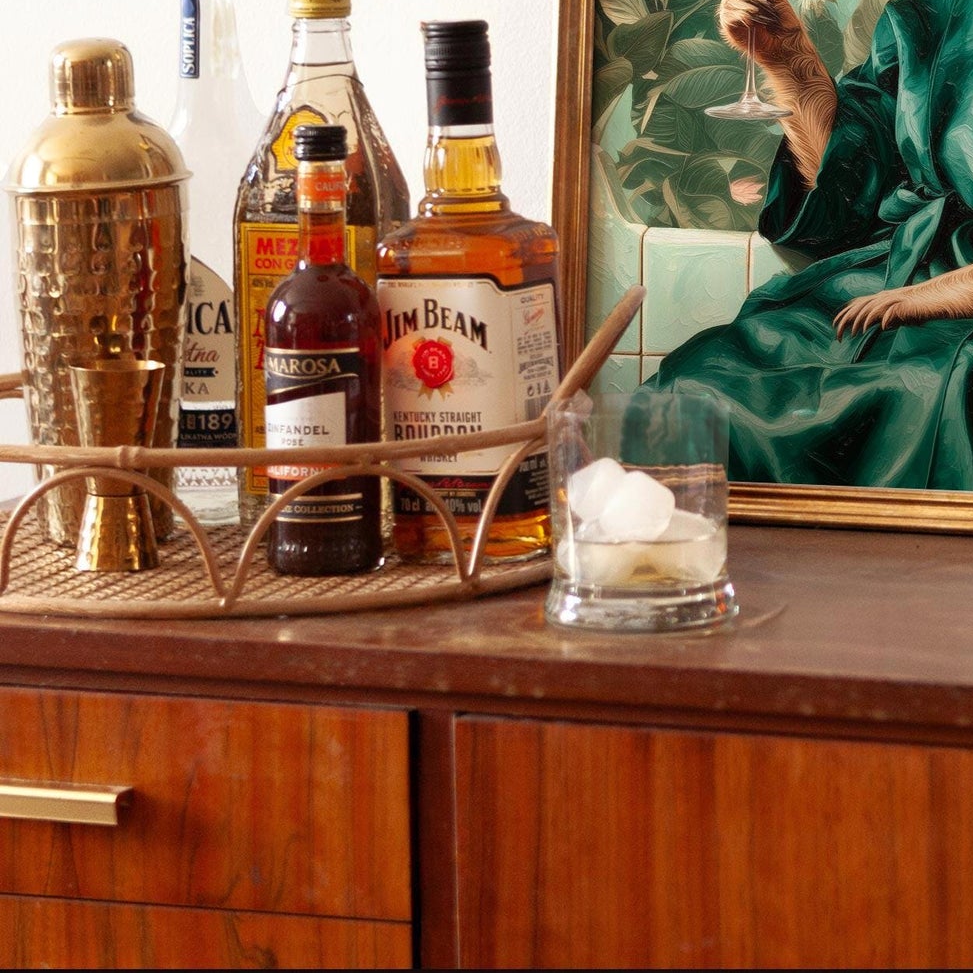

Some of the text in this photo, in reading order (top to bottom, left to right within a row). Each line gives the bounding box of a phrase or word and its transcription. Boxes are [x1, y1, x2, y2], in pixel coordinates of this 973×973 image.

[182, 17, 197, 75] SOPLICA
[255, 258, 282, 269] CON
[186, 300, 233, 335] ICA
[383, 308, 419, 351] JIM
[424, 298, 488, 351] BEAM
[268, 358, 341, 374] MAROSA
[185, 382, 209, 395] KA
[198, 413, 233, 430] 189
[394, 411, 482, 423] KENTUCKY STRAIGHT
[268, 423, 330, 436] ZINFANDEL
[294, 504, 354, 514] COLLECTION
